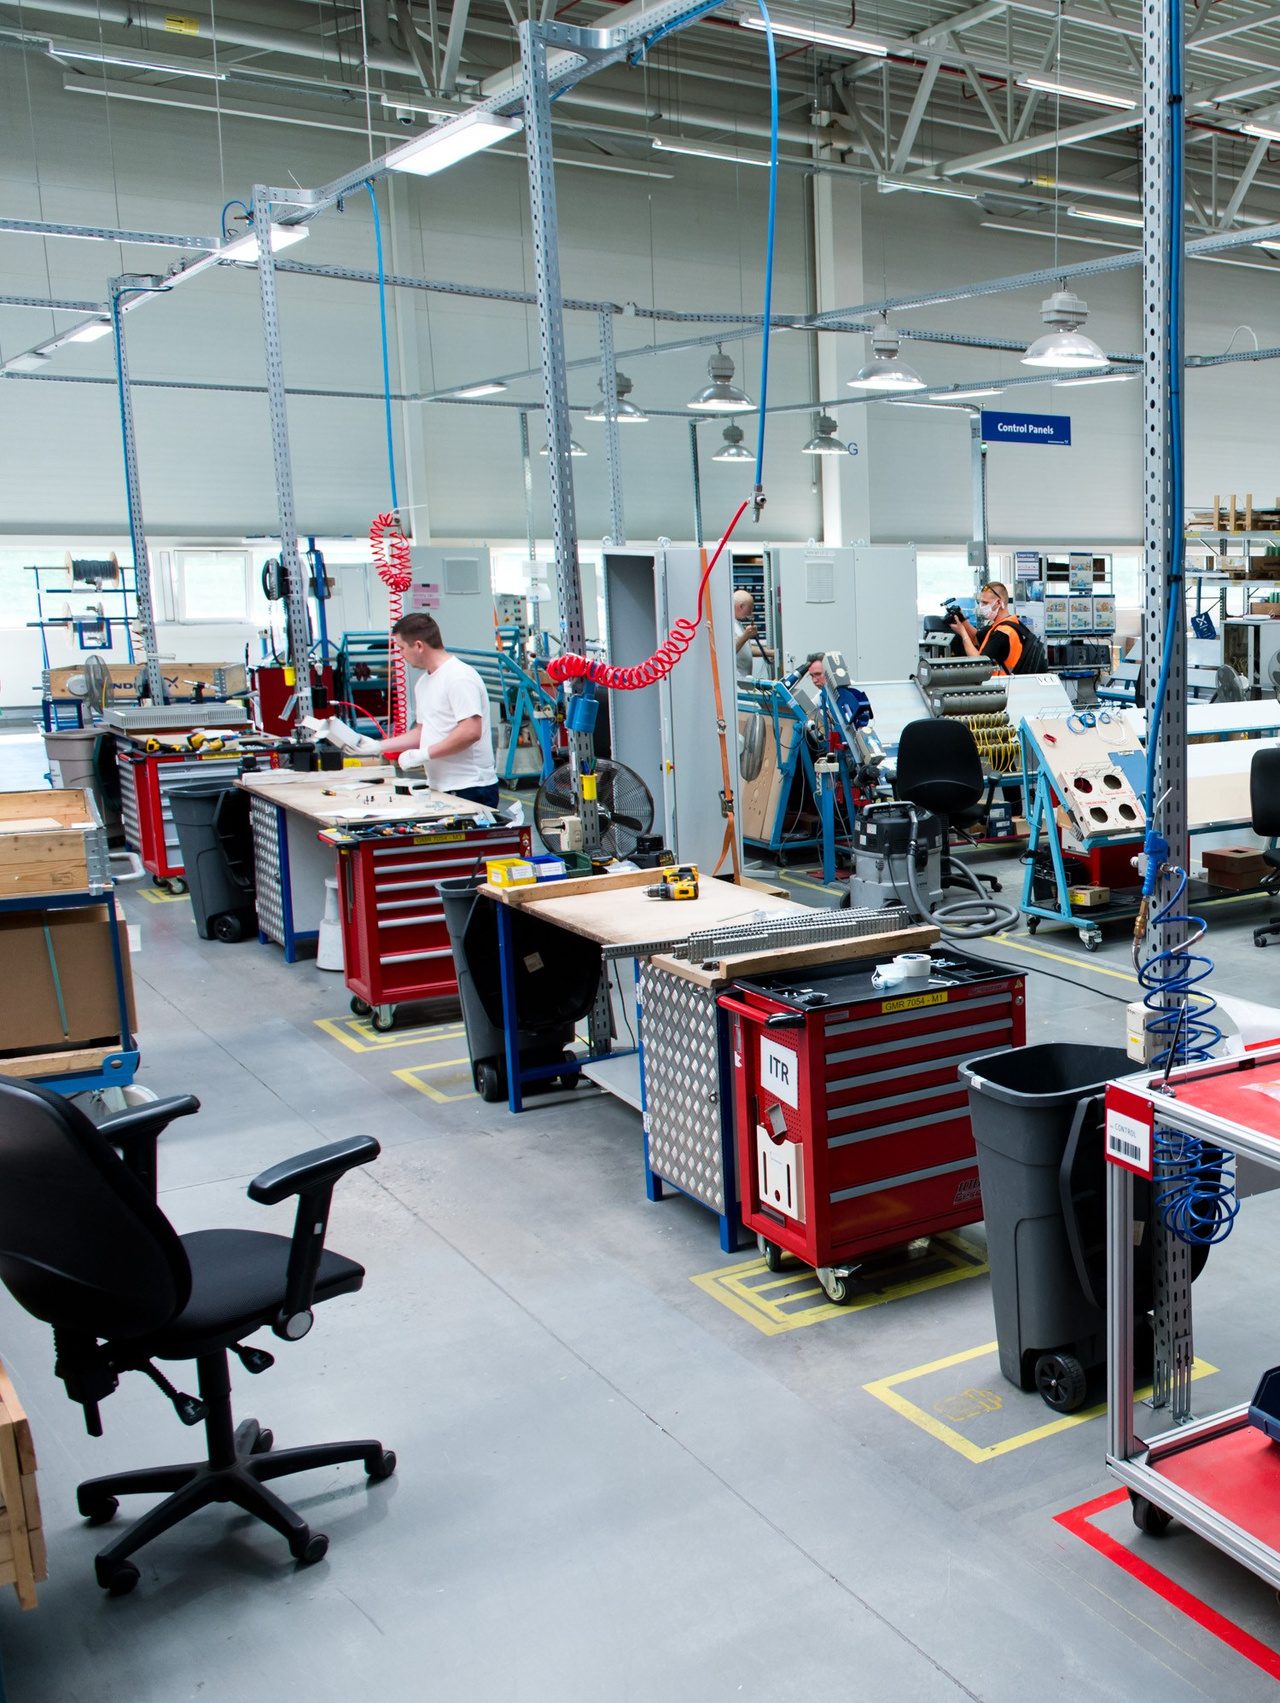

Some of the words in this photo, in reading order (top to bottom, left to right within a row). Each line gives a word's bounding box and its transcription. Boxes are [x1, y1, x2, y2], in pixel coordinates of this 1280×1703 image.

[997, 422, 1028, 434] Control
[1028, 423, 1054, 436] Panels
[885, 1000, 905, 1011] GMR
[907, 997, 925, 1007] 7054
[932, 994, 943, 1003] M1
[768, 1054, 789, 1085] ITR
[1114, 1122, 1137, 1139] CONTROL
